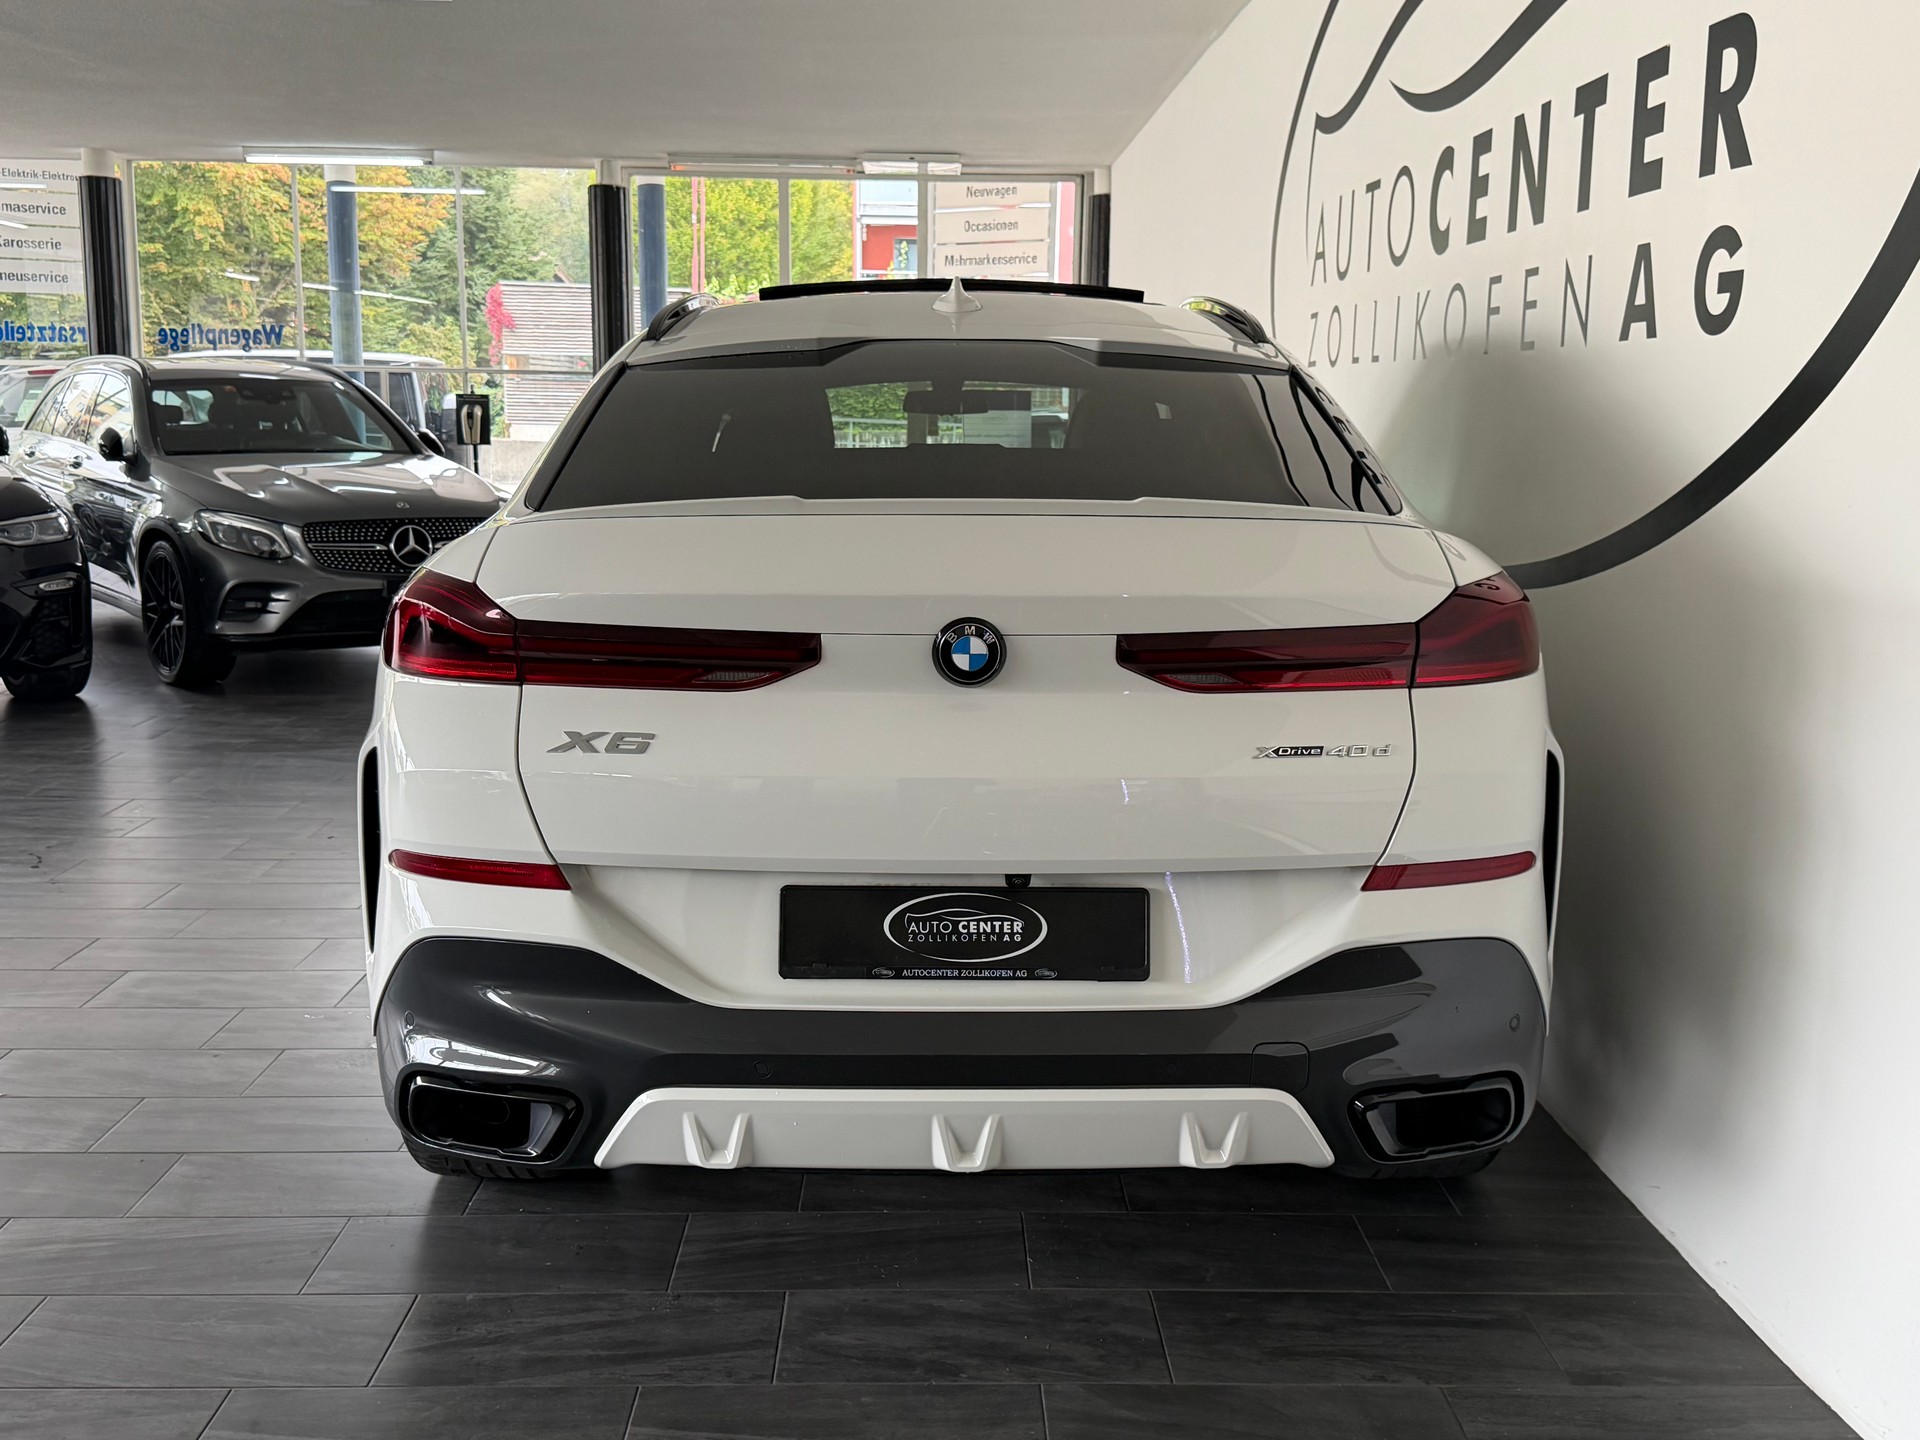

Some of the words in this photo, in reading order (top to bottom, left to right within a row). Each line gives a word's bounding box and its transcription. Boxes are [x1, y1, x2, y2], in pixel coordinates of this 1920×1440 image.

[966, 186, 1018, 199] Neuwagen
[946, 626, 996, 644] BMW
[546, 731, 656, 754] X6
[908, 921, 953, 933] AUTO
[958, 921, 1023, 933] CENTER
[908, 934, 997, 942] ZOLLIKOFEN
[1003, 934, 1022, 942] AG
[902, 969, 959, 977] AUTOCENTER
[961, 969, 1013, 977] ZOLLIKOFEN
[1015, 969, 1028, 978] AG
